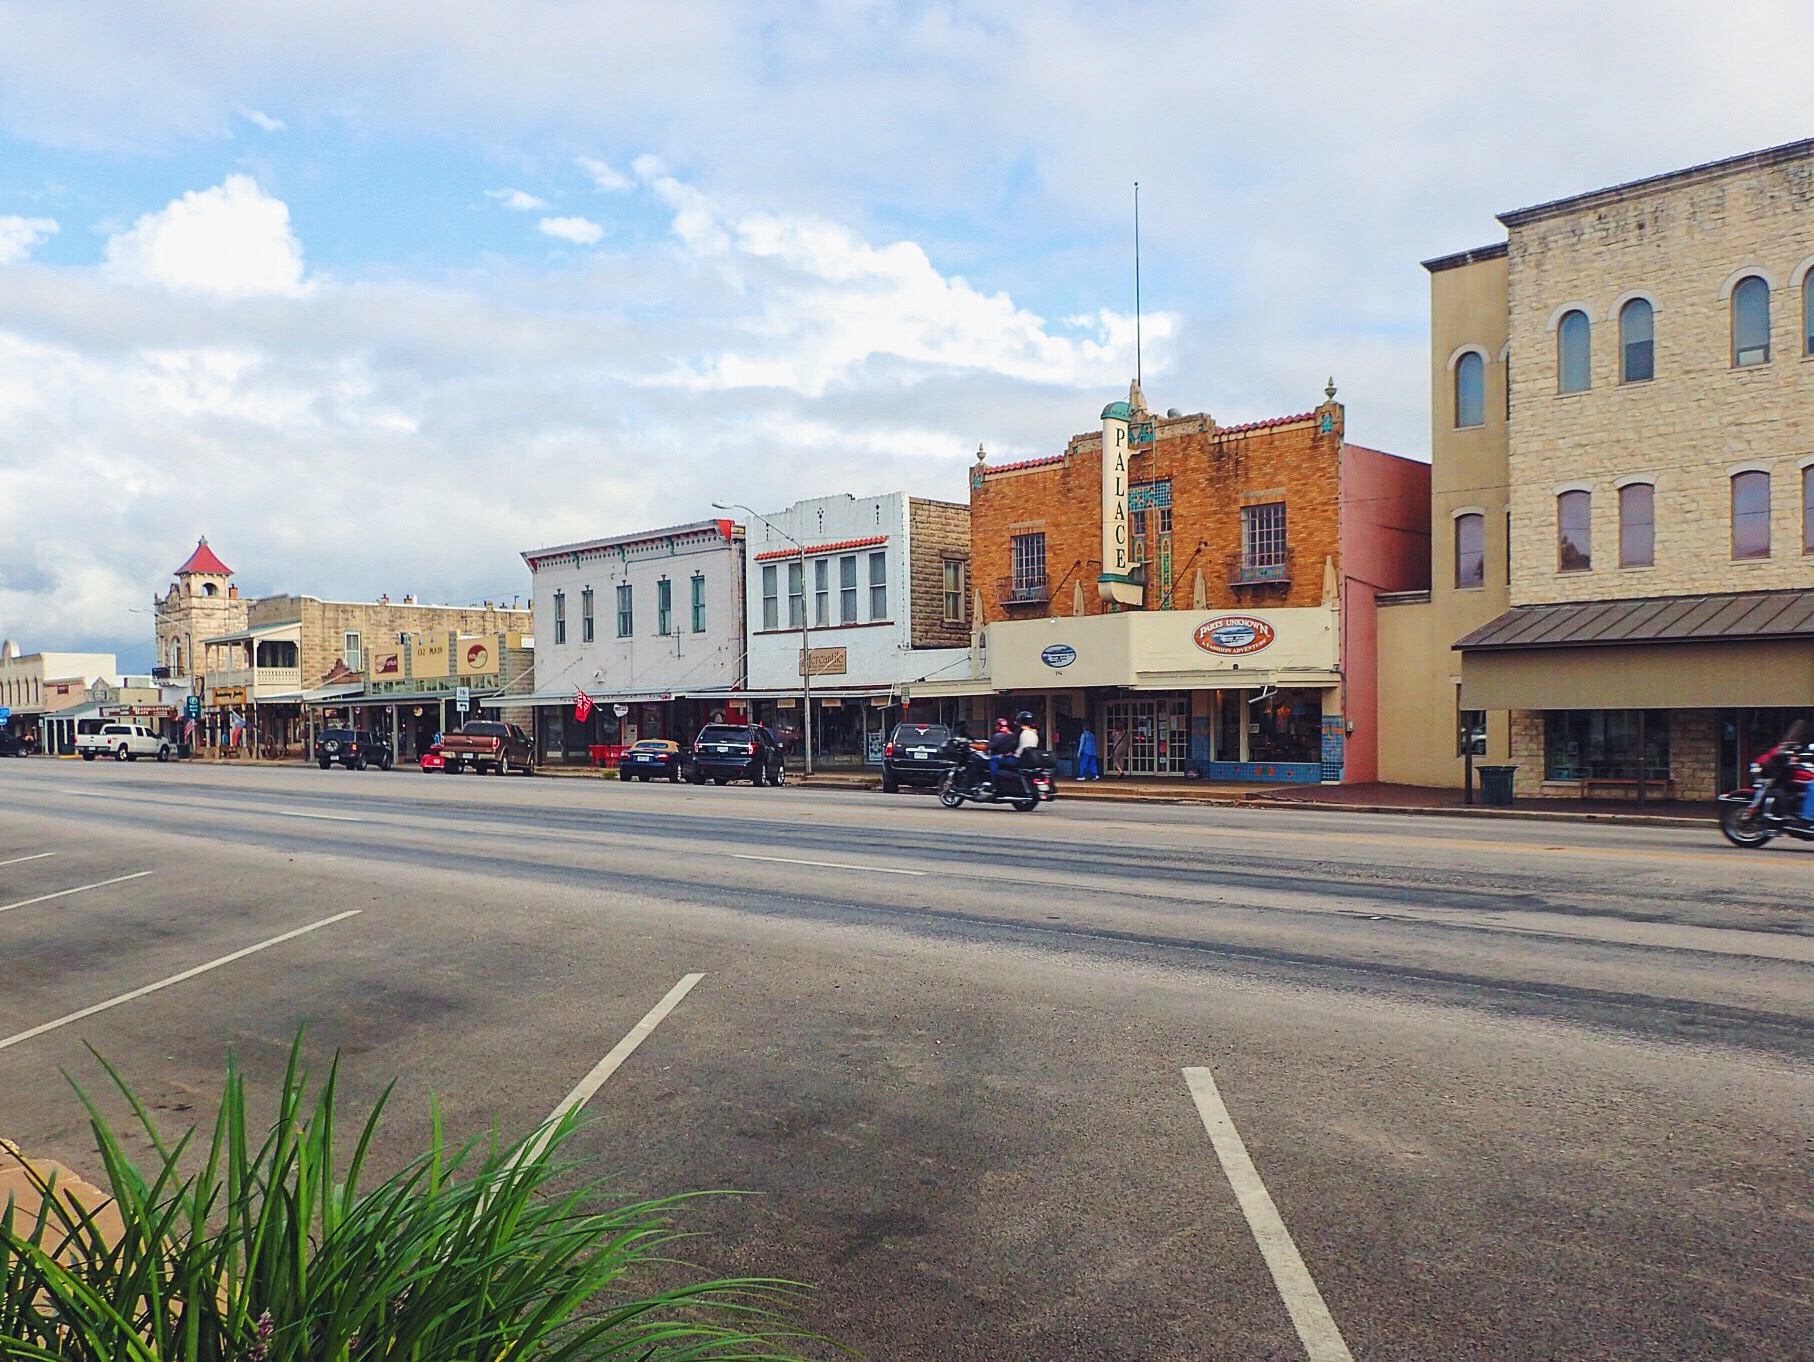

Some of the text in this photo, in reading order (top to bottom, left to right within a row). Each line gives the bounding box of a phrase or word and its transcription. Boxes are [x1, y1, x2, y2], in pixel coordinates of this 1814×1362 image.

[1115, 428, 1125, 568] PALACE
[1200, 621, 1223, 638] PARTS
[429, 647, 443, 656] MAIN
[1232, 639, 1267, 653] ADVENTURE
